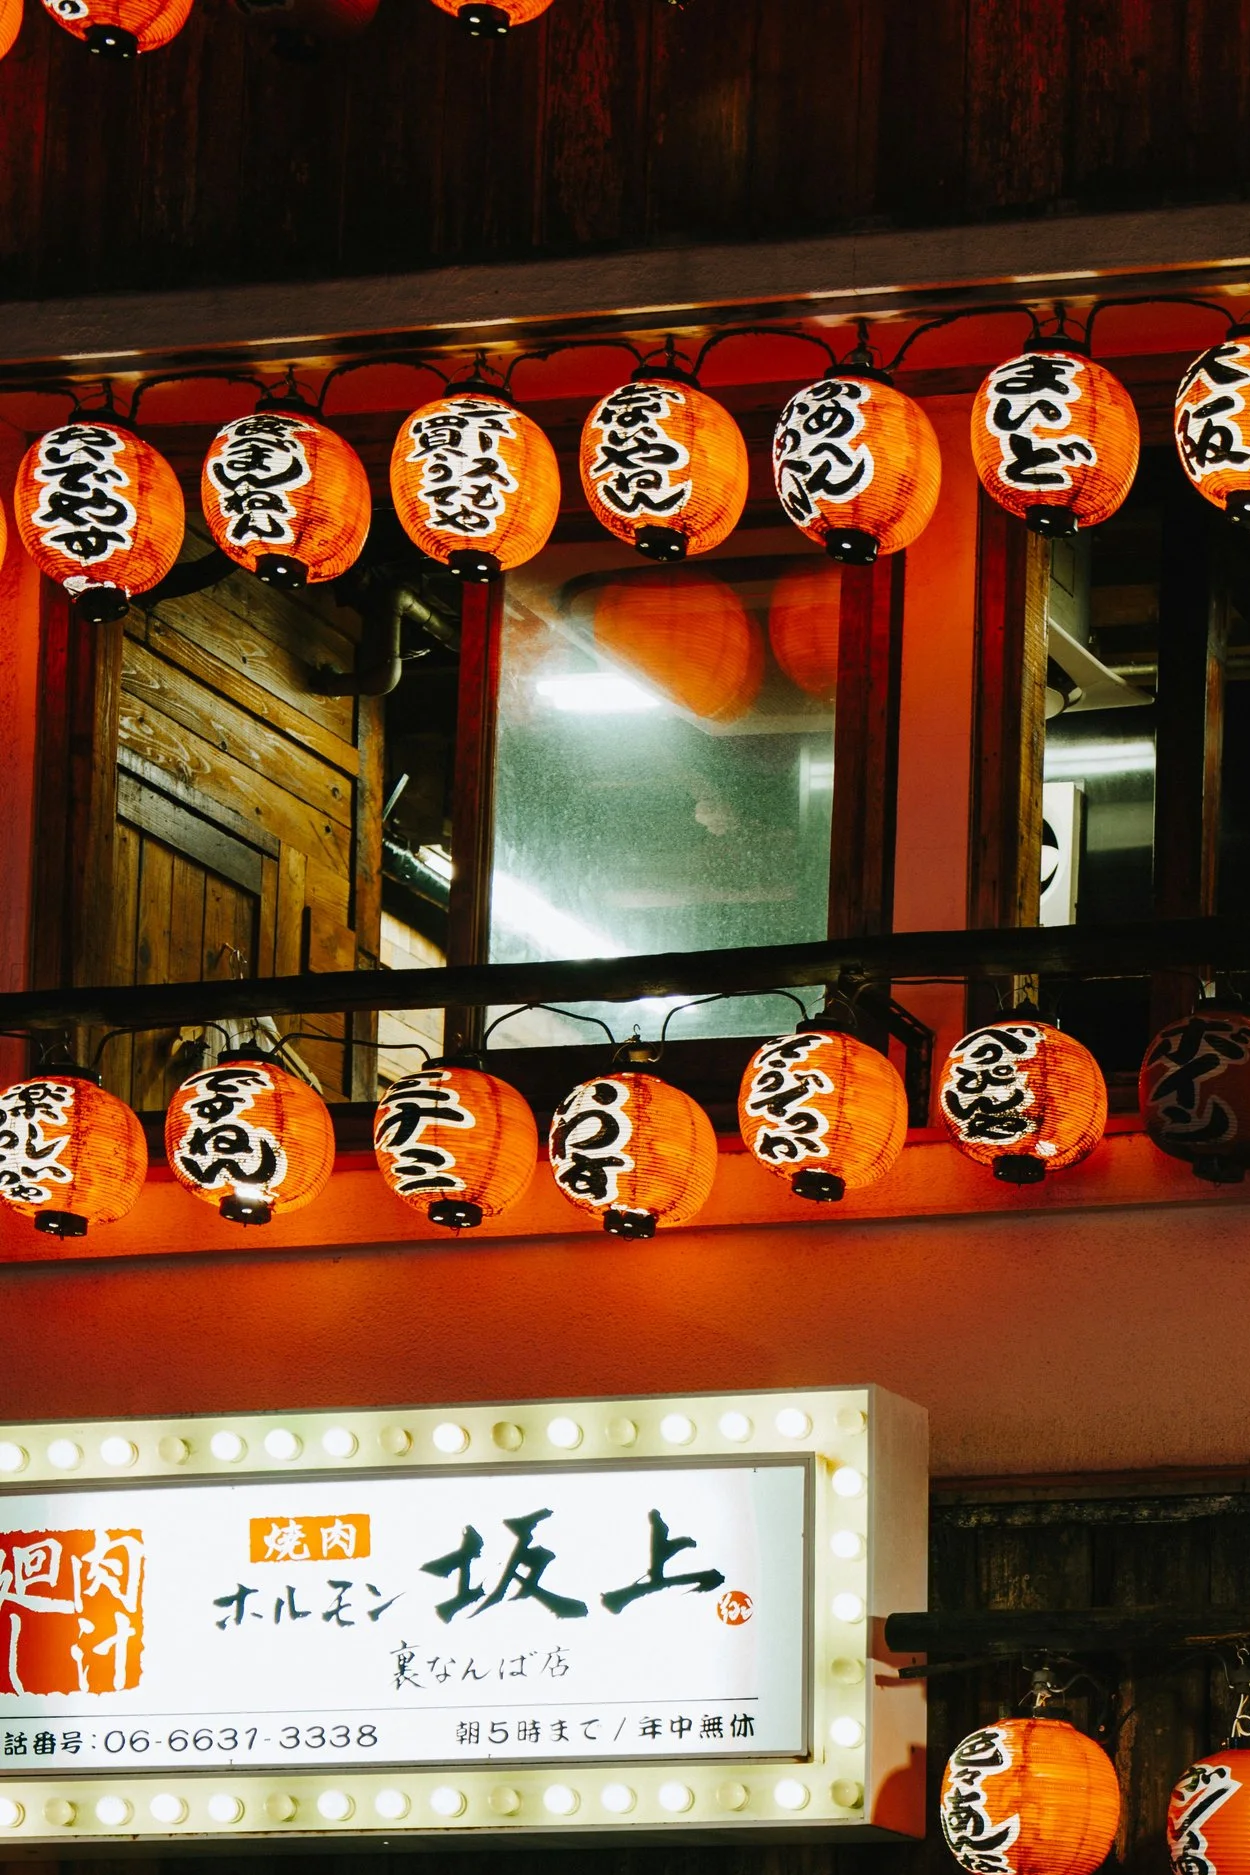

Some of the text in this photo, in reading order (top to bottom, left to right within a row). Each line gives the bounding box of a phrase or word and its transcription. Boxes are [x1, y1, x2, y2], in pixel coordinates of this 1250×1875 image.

[994, 355, 1093, 484] まいど
[40, 426, 129, 560] おいでやす
[213, 415, 307, 541] 食べまんねん
[180, 1069, 277, 1184] ですねん
[263, 1520, 358, 1560] 焼肉
[421, 1507, 726, 1625] 坂上
[213, 1579, 406, 1631] ホルモン
[390, 1640, 571, 1691] 裏なんば店
